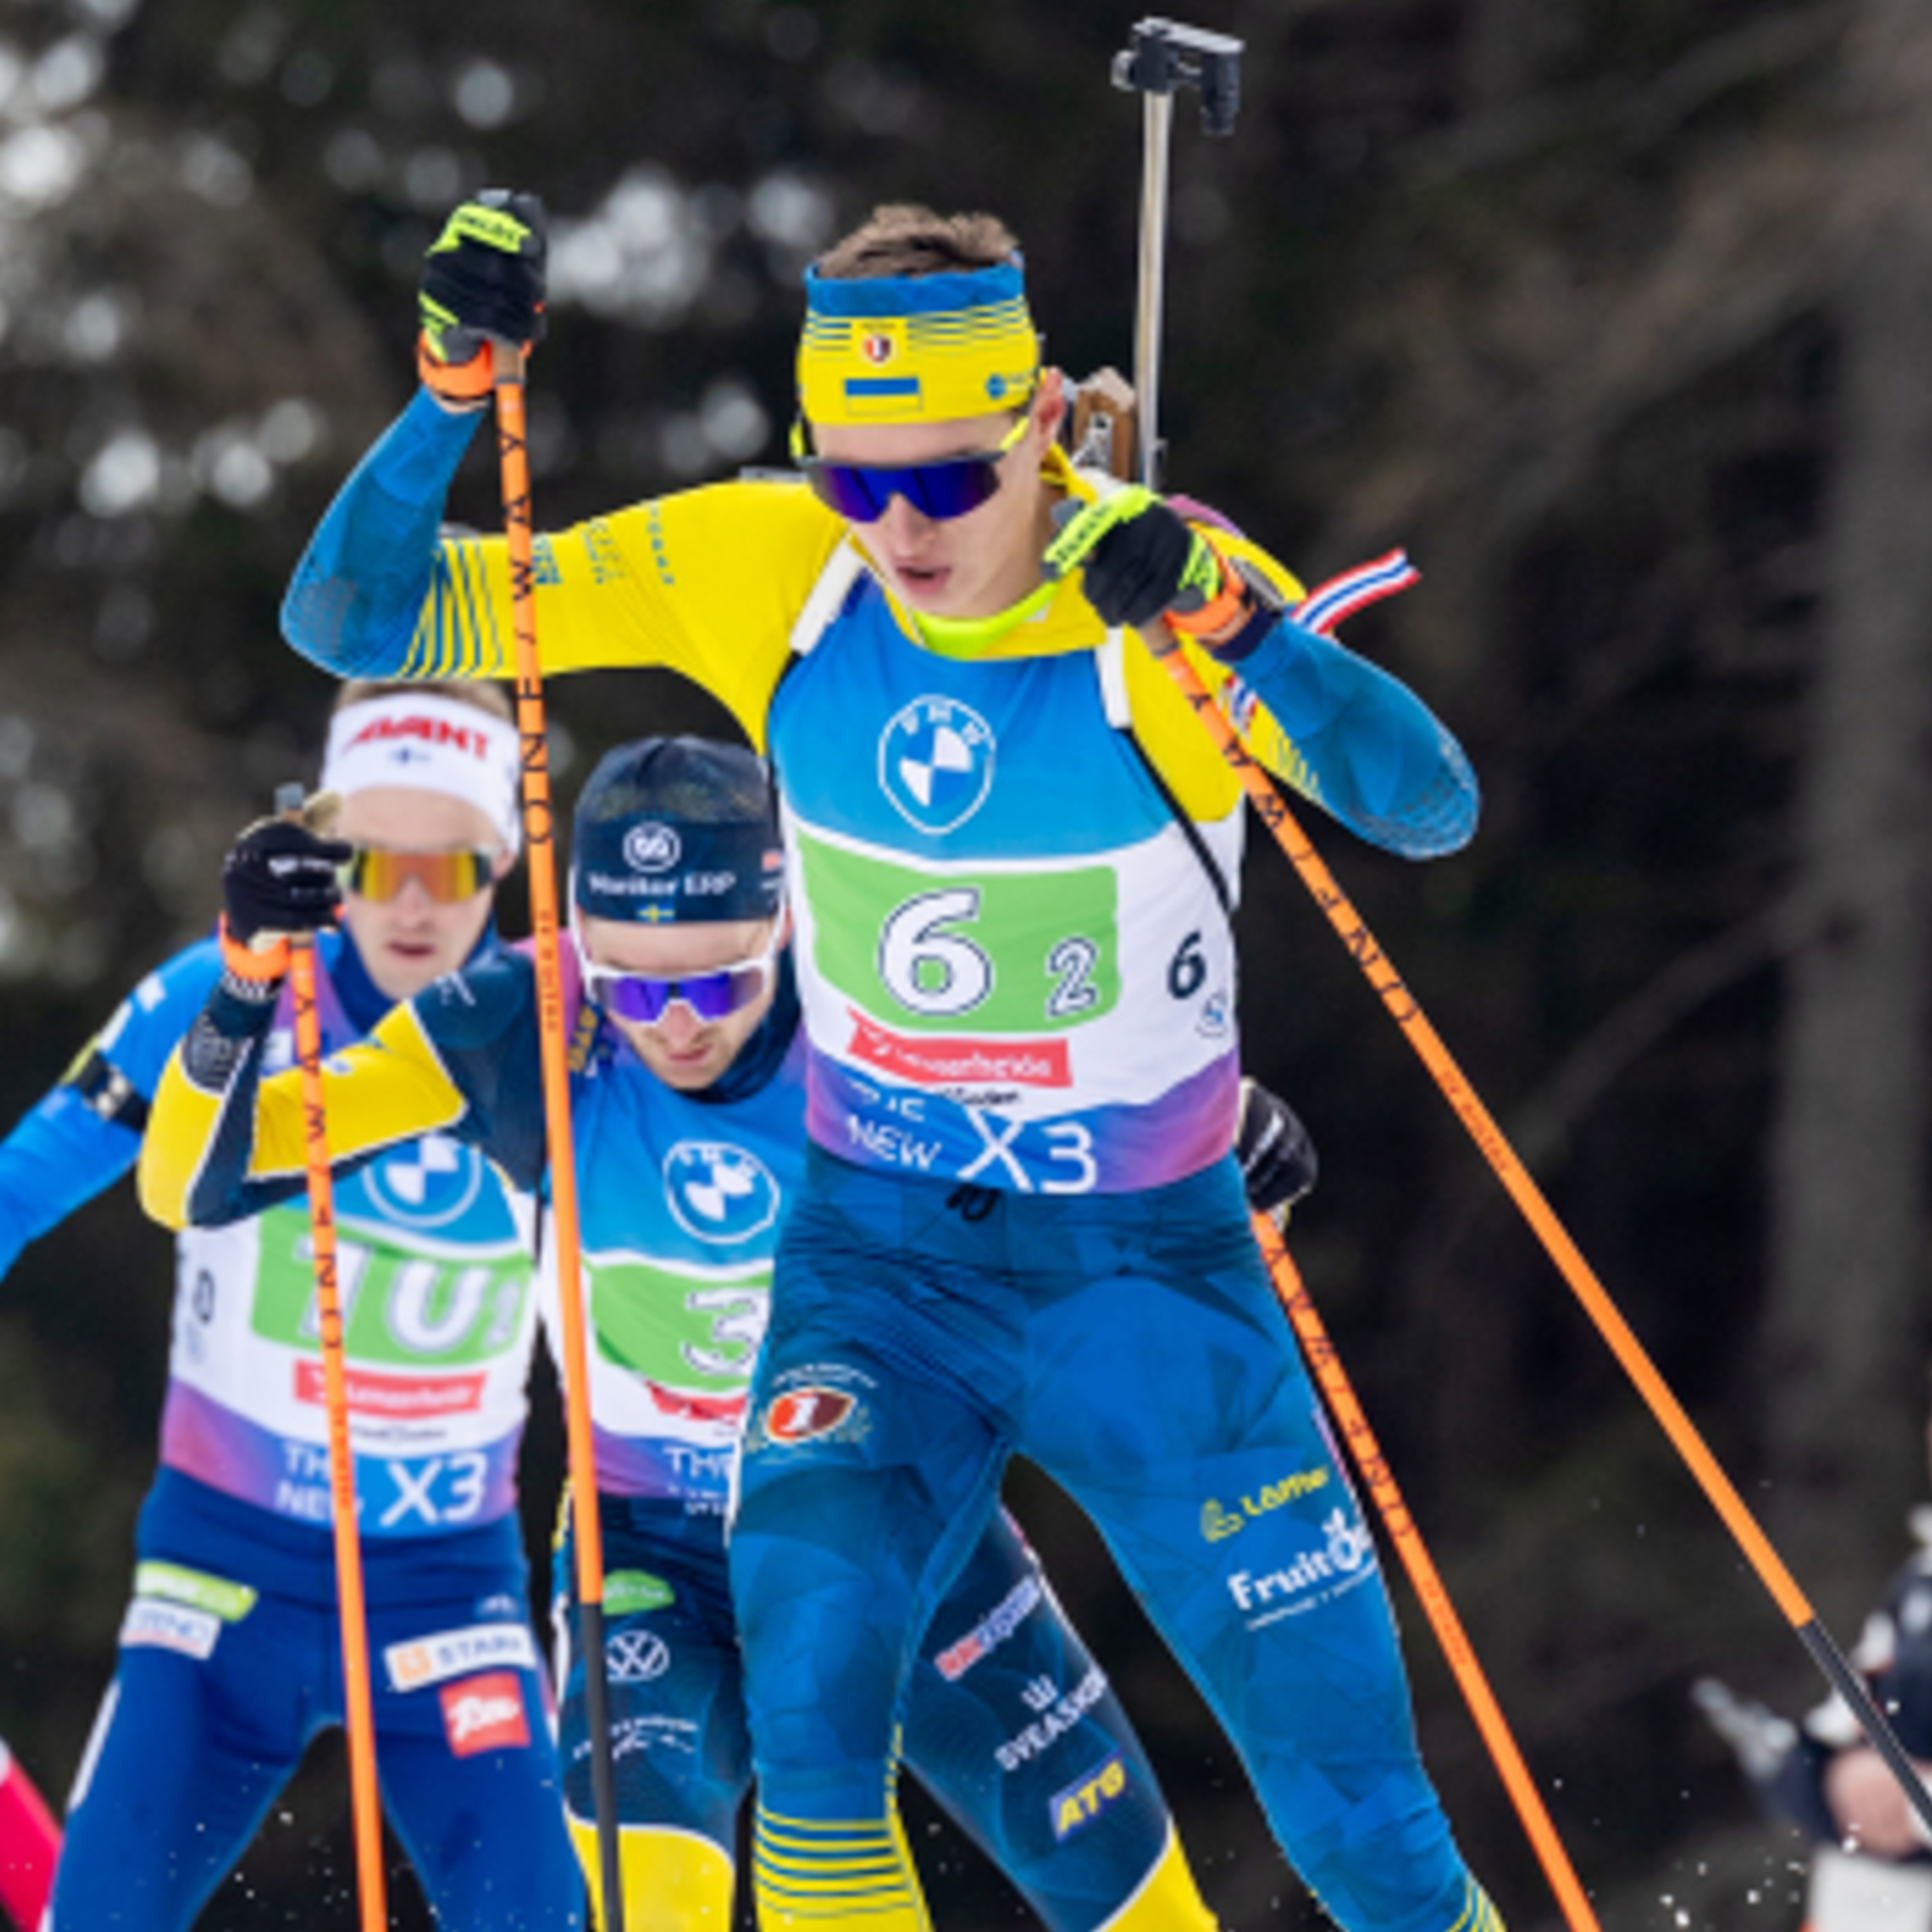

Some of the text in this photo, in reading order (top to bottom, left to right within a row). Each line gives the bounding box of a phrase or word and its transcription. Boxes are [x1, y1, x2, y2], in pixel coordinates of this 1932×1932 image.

[878, 886, 992, 1016] 6
[1046, 936, 1097, 1018] 2
[1167, 929, 1207, 999] 6
[847, 1114, 943, 1170] NEW
[956, 1108, 1097, 1195] X3
[681, 1290, 770, 1376] 3
[379, 1452, 488, 1527] X3
